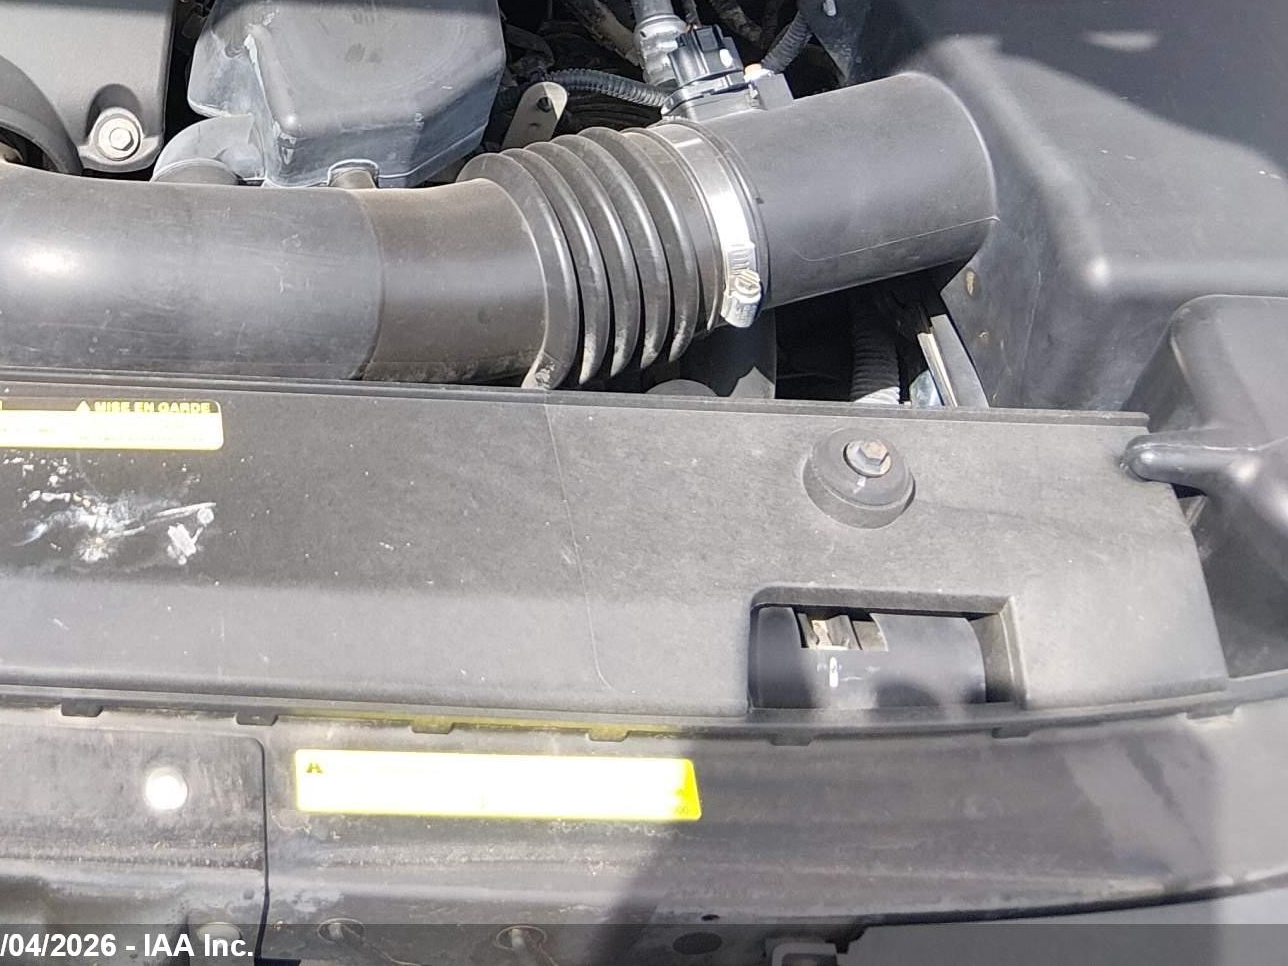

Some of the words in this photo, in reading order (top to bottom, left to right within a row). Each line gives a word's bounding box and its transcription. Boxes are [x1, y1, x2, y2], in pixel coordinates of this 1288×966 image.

[94, 401, 130, 413] MISE
[134, 402, 154, 413] EN
[157, 402, 211, 414] GARDE
